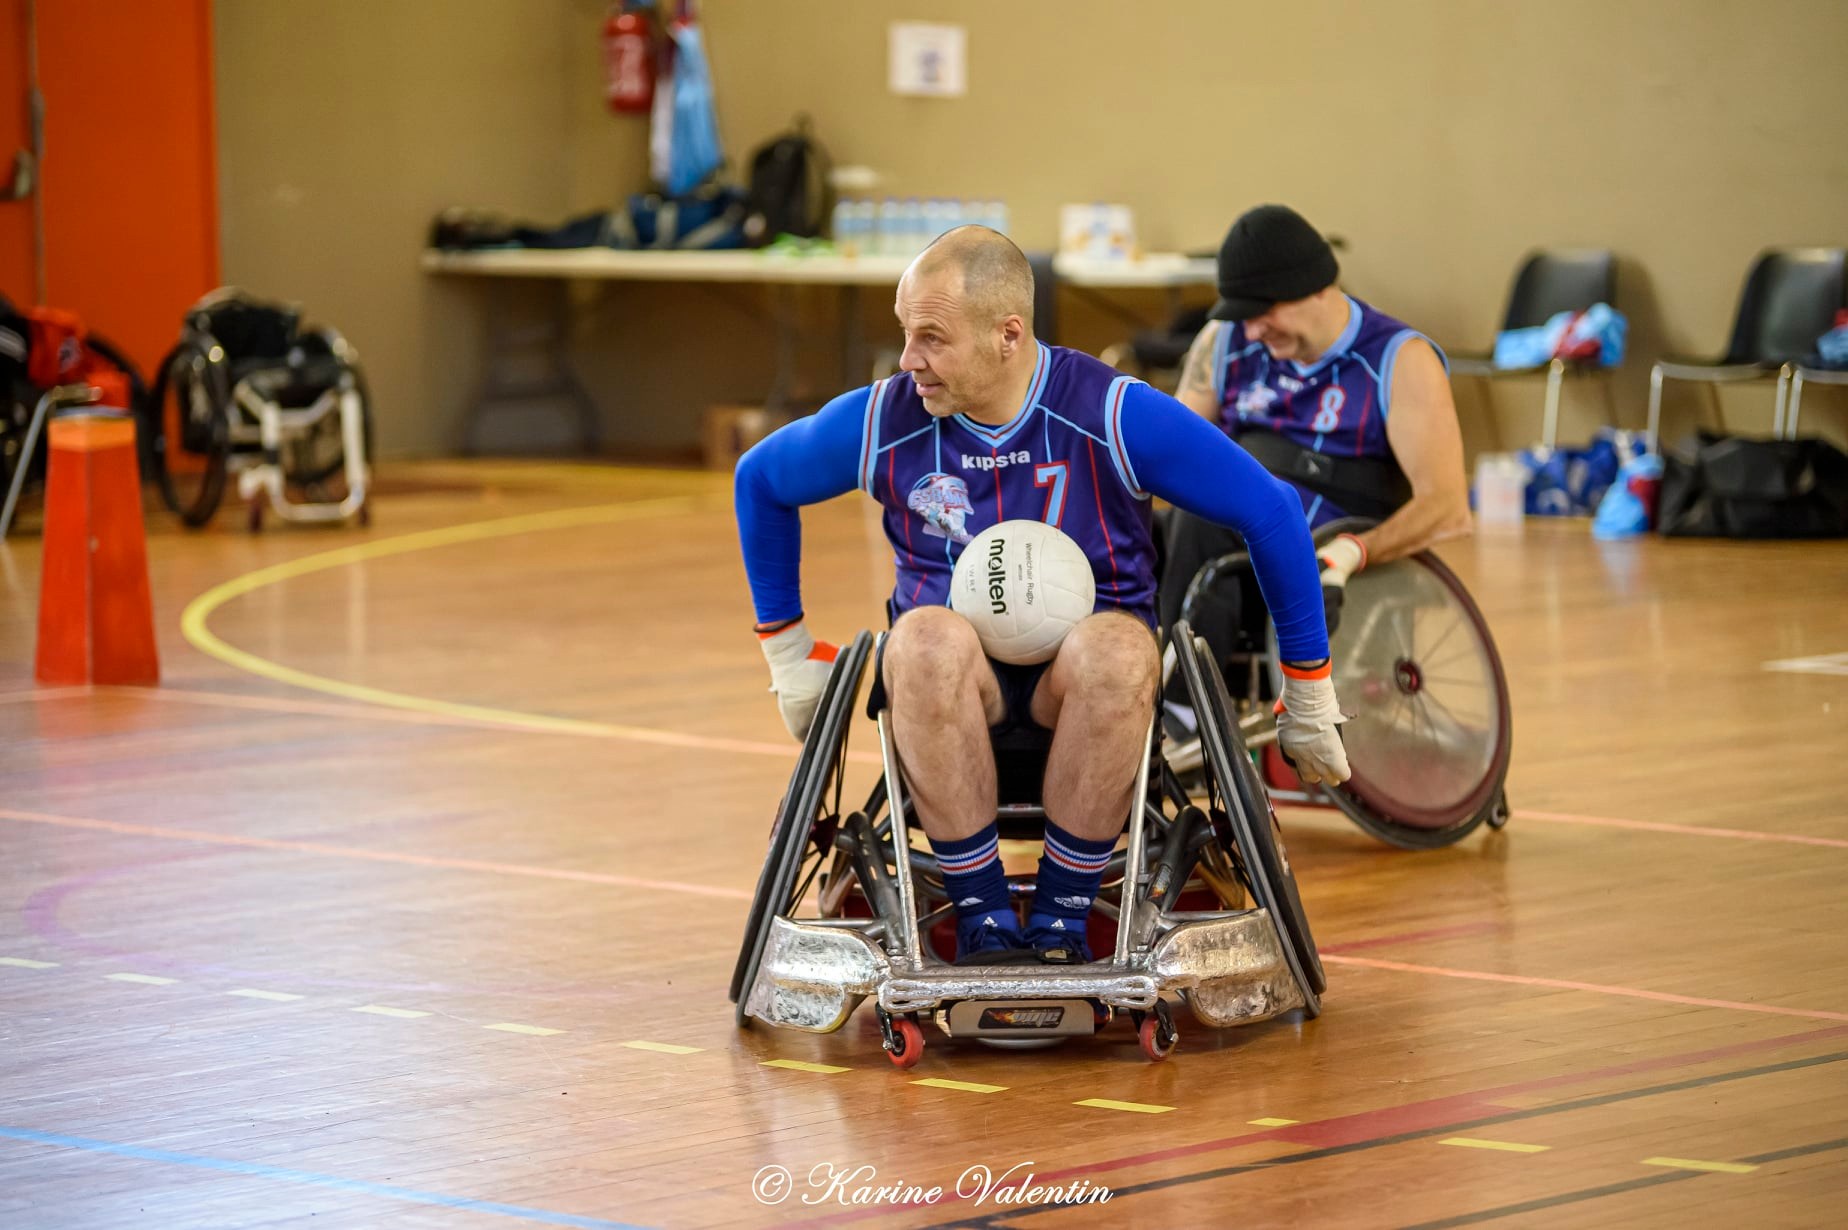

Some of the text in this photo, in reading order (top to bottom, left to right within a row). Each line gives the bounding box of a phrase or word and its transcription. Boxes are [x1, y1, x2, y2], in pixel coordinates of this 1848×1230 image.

[1314, 385, 1345, 433] 8
[961, 450, 1030, 471] kipsta
[1034, 459, 1070, 529] 7
[988, 538, 1007, 615] molten
[1025, 542, 1035, 606] Wheelchair Rugby
